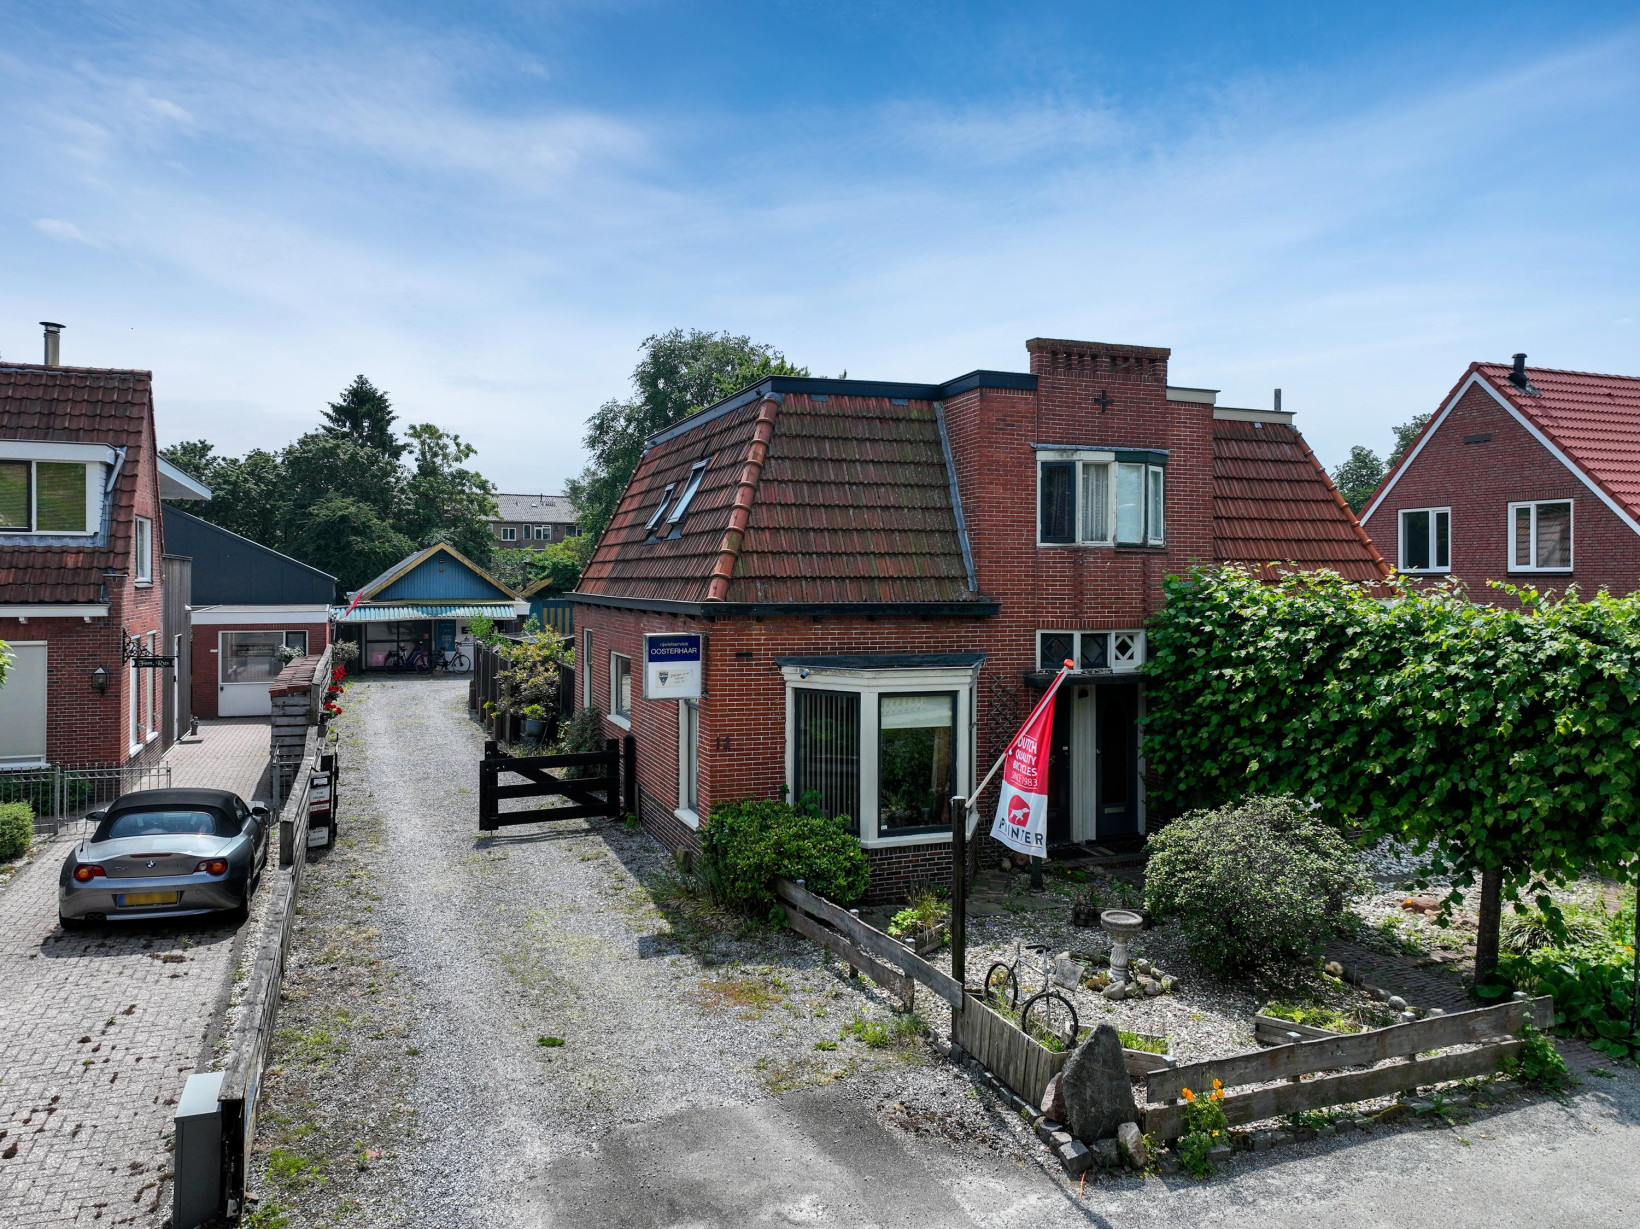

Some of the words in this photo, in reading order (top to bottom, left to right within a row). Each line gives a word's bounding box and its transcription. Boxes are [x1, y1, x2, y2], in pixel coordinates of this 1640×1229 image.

[650, 647, 698, 655] OOSTERHAAR
[1017, 736, 1037, 754] DUTCH
[1015, 749, 1037, 765] QUALITY
[1012, 760, 1038, 777] BICYCLES
[1011, 770, 1022, 783] SINCE
[1022, 776, 1038, 787] 1983
[999, 817, 1044, 846] PINTER
